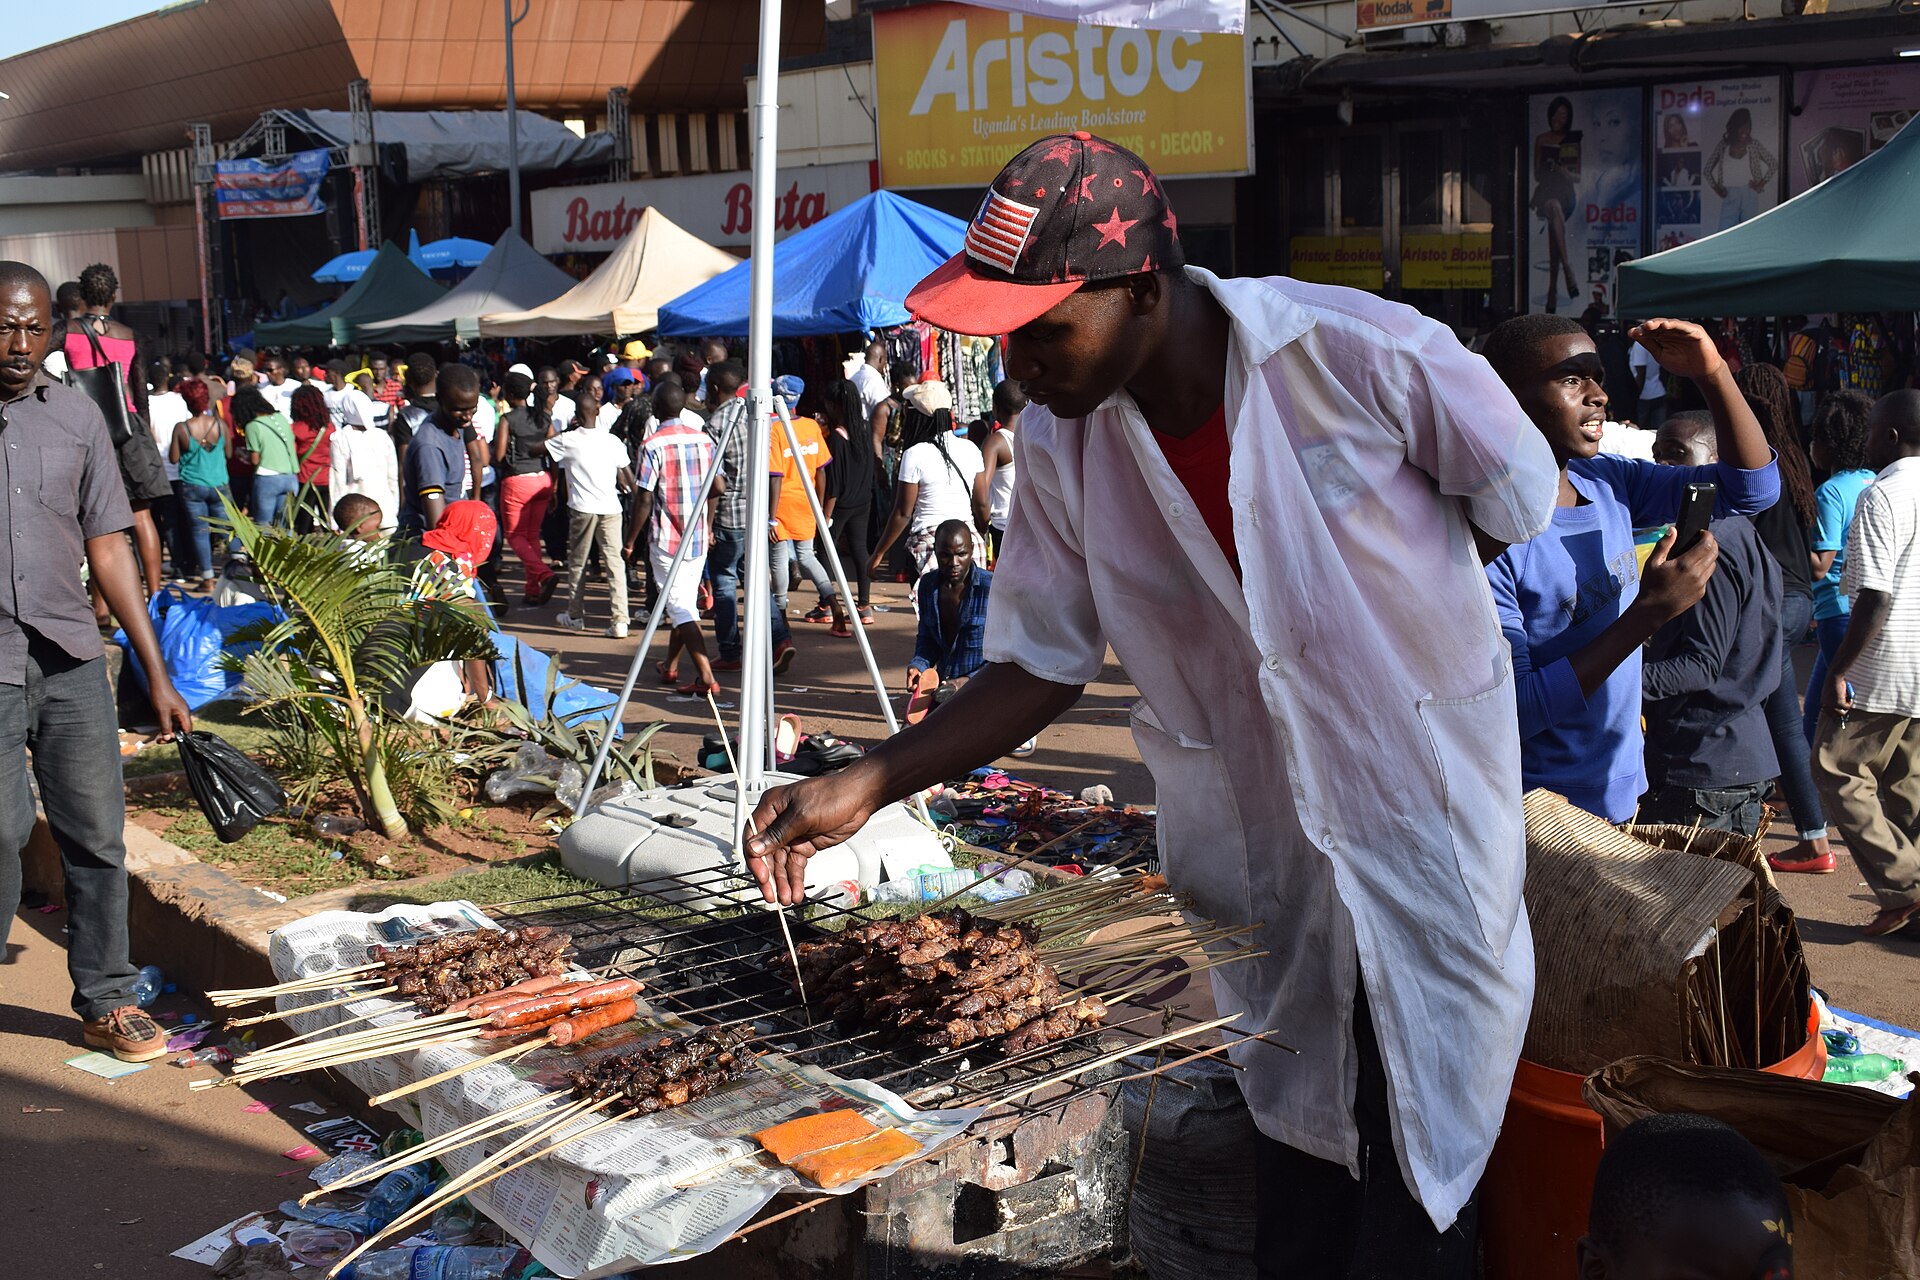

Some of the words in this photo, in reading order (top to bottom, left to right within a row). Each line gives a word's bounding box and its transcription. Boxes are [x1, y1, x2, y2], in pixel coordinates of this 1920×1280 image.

[1376, 0, 1413, 16] Kodak
[909, 13, 1204, 116] Aristoc
[1661, 86, 1715, 110] Dada
[973, 114, 1027, 138] Uganda's
[1030, 110, 1078, 132] Leading
[1081, 107, 1146, 128] Bookstore
[906, 148, 947, 170] BOOKS
[1160, 130, 1214, 155] DECOR
[1585, 202, 1637, 223] Dada
[1292, 249, 1330, 262] Aristoc
[1403, 247, 1447, 261] Aristoc
[1451, 247, 1492, 261] Bookl
